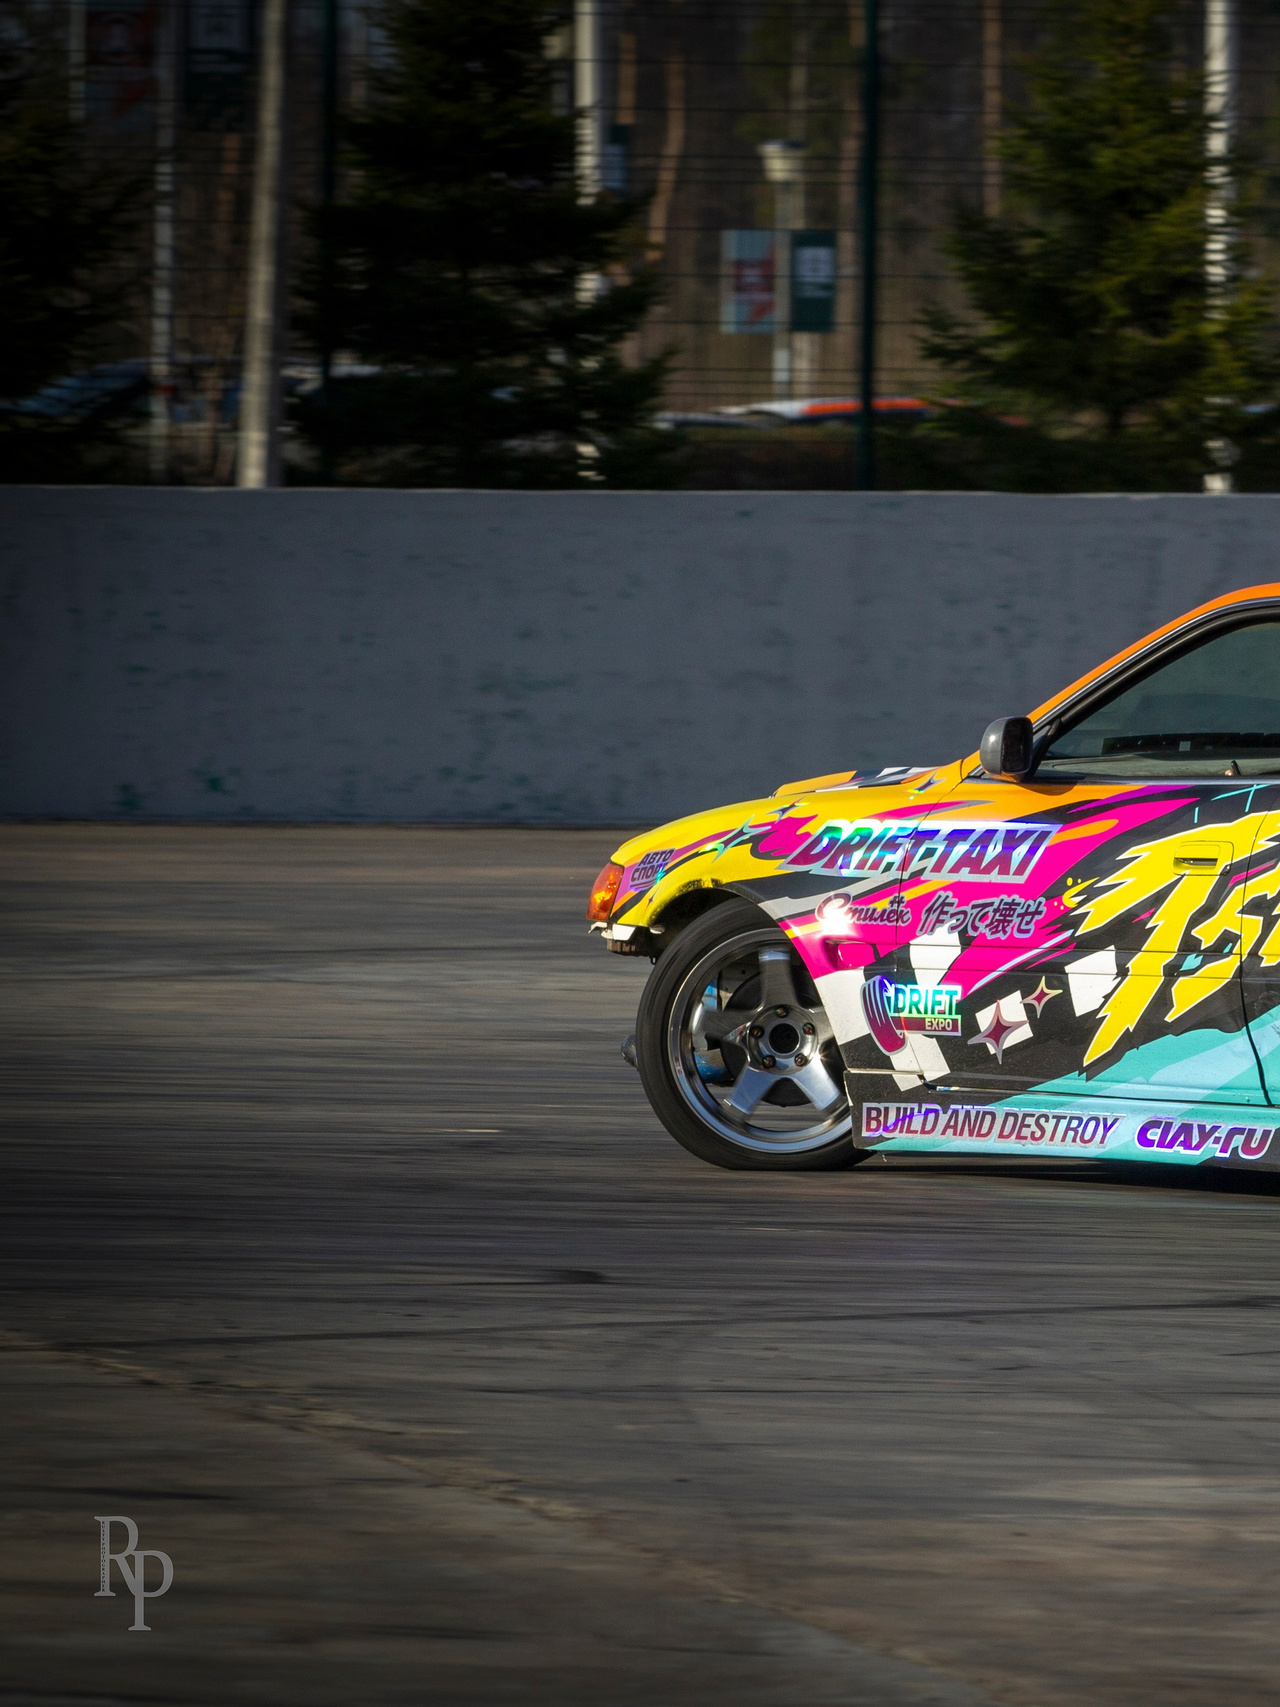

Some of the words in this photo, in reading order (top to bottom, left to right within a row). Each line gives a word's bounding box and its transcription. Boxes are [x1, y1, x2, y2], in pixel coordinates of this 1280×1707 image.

[637, 849, 675, 867] АВТО
[786, 824, 941, 872] DRIFT
[929, 828, 1053, 876] TAXI
[919, 894, 1044, 936] 作って壊せ
[893, 987, 958, 1015] DRIFT
[925, 1018, 952, 1031] EXPO
[865, 1106, 940, 1136] BUILD
[940, 1110, 997, 1138] AND
[997, 1112, 1120, 1145] DESTROY
